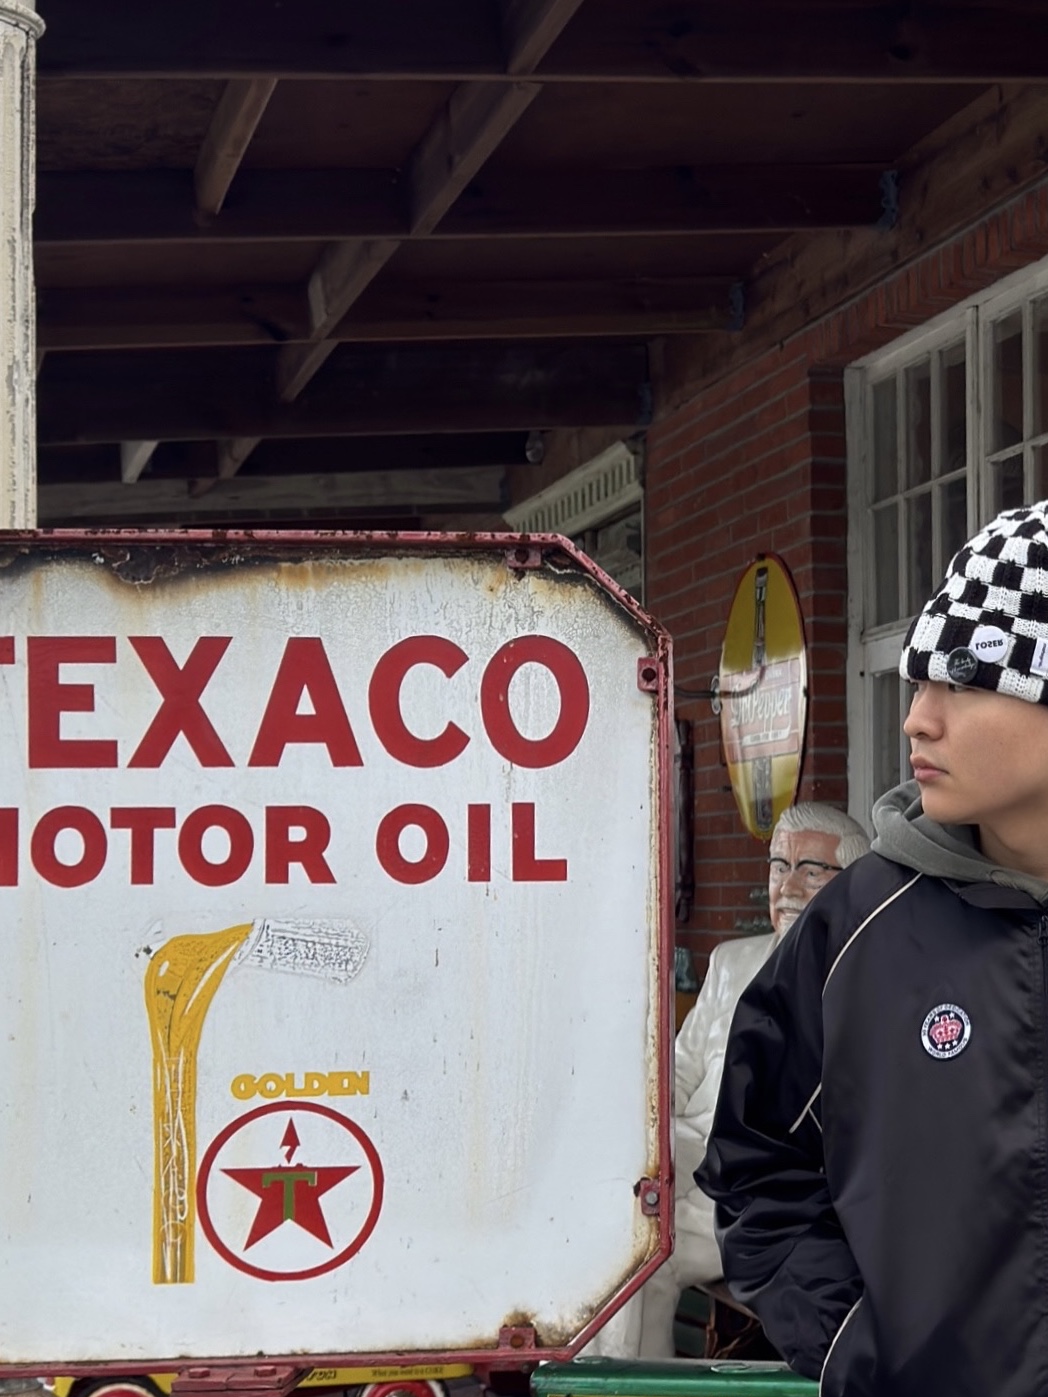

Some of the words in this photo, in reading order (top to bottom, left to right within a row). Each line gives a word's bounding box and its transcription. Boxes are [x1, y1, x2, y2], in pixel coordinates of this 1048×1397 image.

[0, 634, 590, 769] EXACO
[0, 804, 337, 888] OTOR
[376, 802, 568, 885] OIL
[261, 1171, 318, 1222] T
